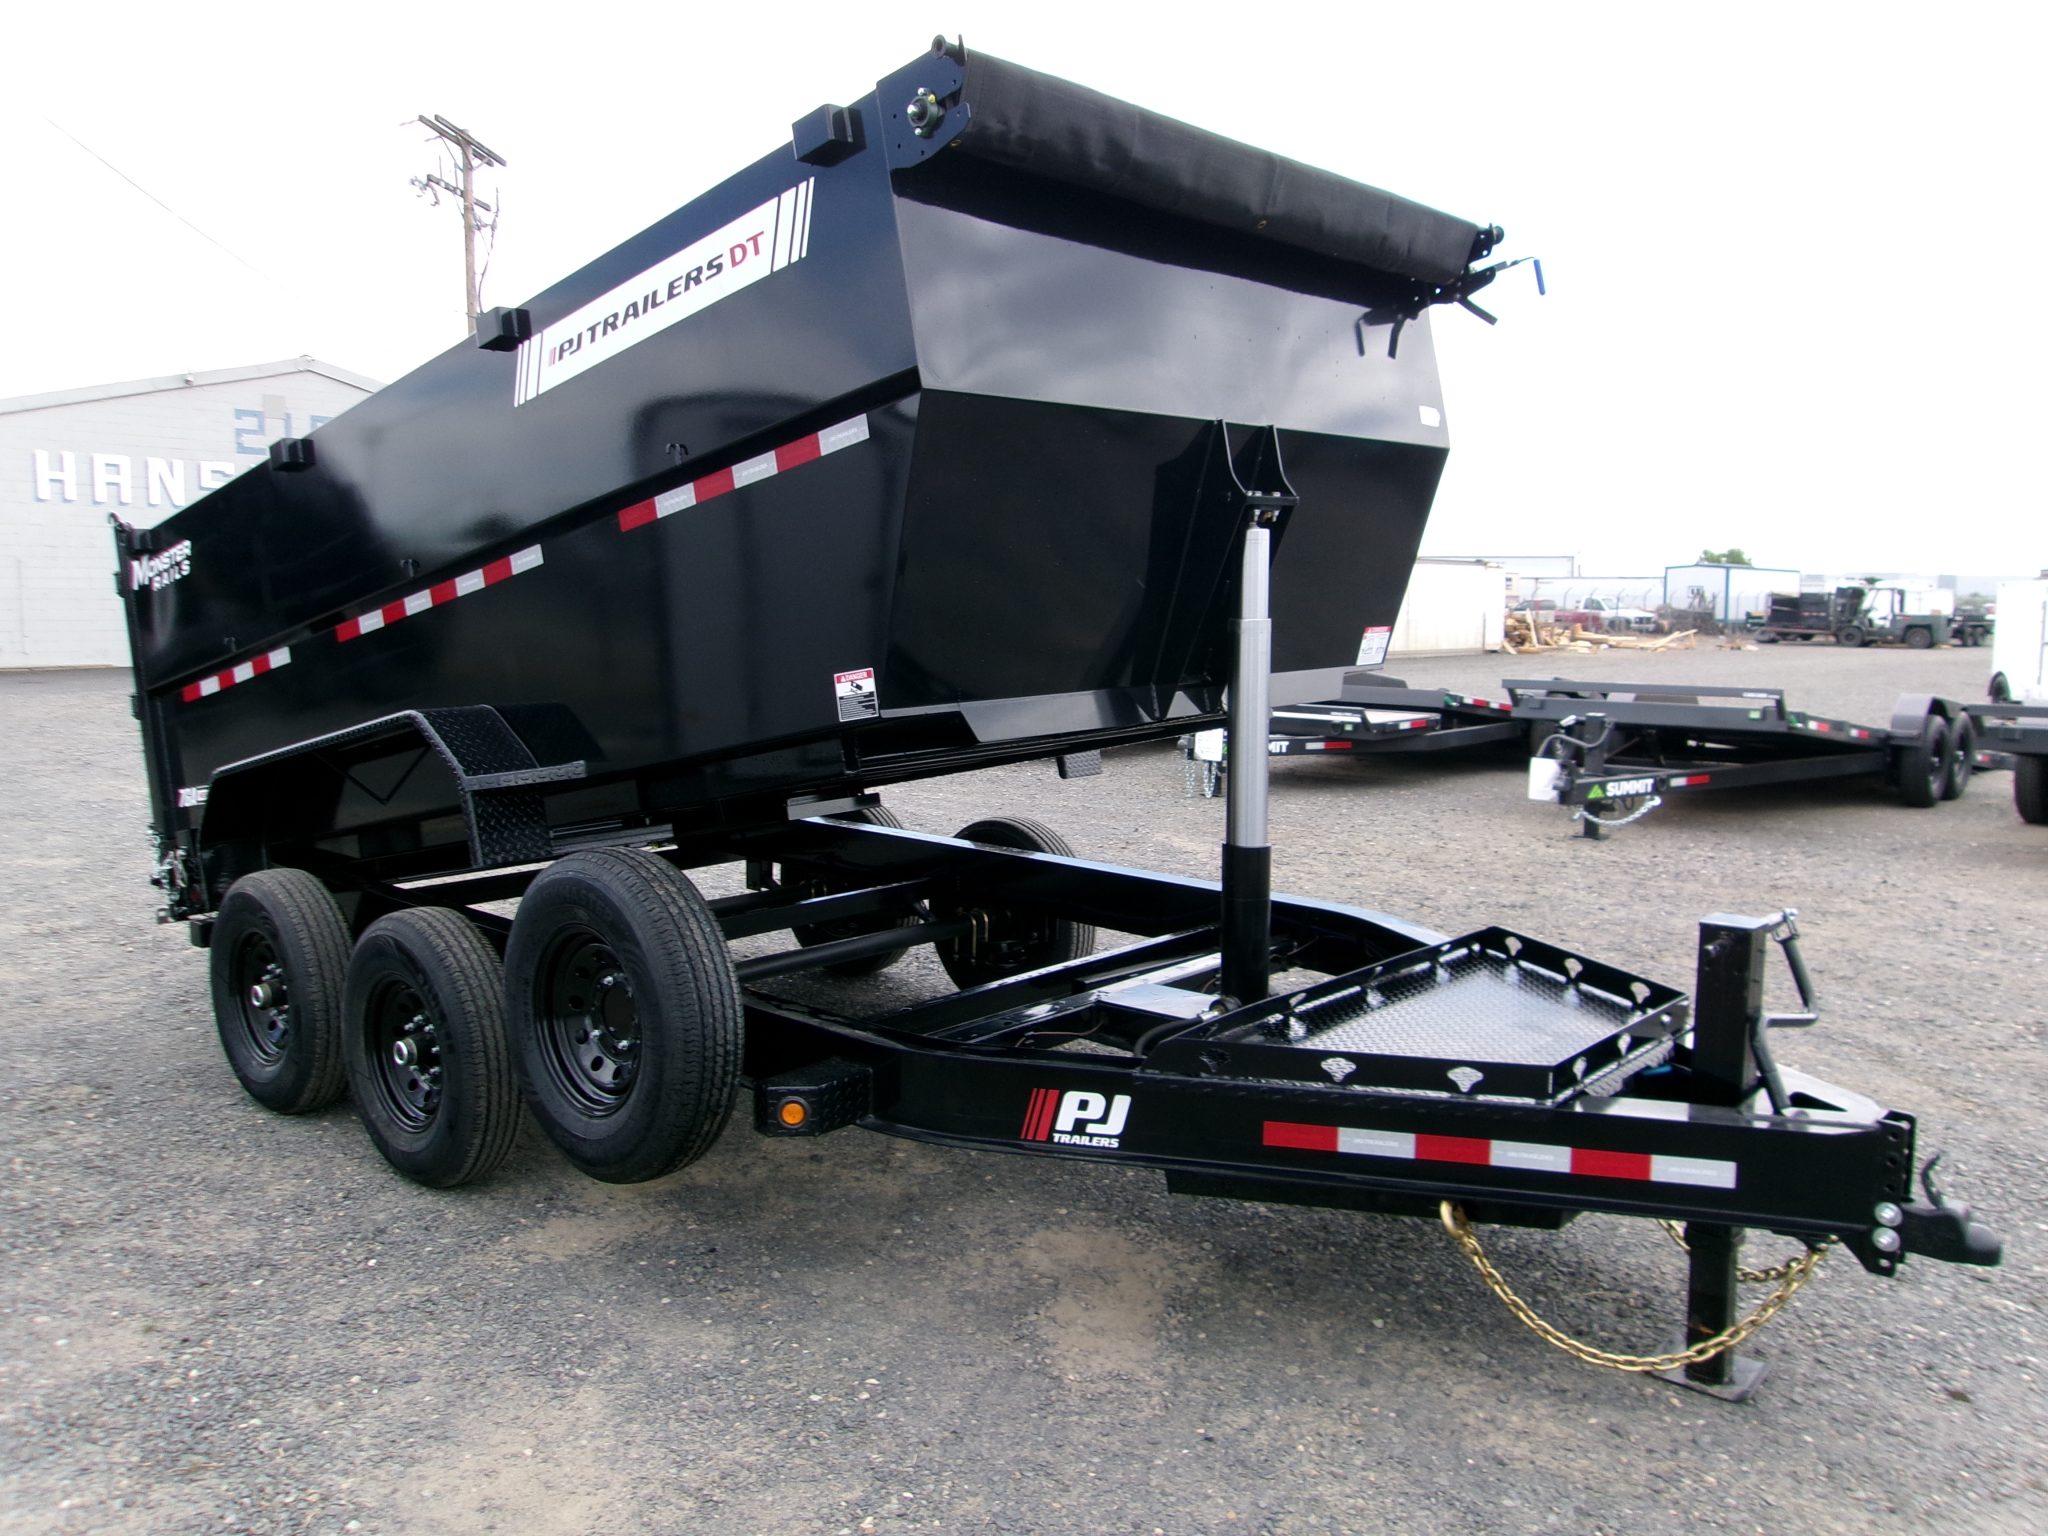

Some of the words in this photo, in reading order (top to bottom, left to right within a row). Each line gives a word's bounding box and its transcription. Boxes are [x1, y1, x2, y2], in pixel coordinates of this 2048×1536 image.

[585, 253, 724, 345] TRAILERS
[729, 230, 765, 269] DT
[34, 449, 238, 507] HANS
[1606, 778, 1655, 797] SUMMIT
[1055, 1090, 1132, 1136] PJ
[1053, 1133, 1120, 1149] TRAILERS
